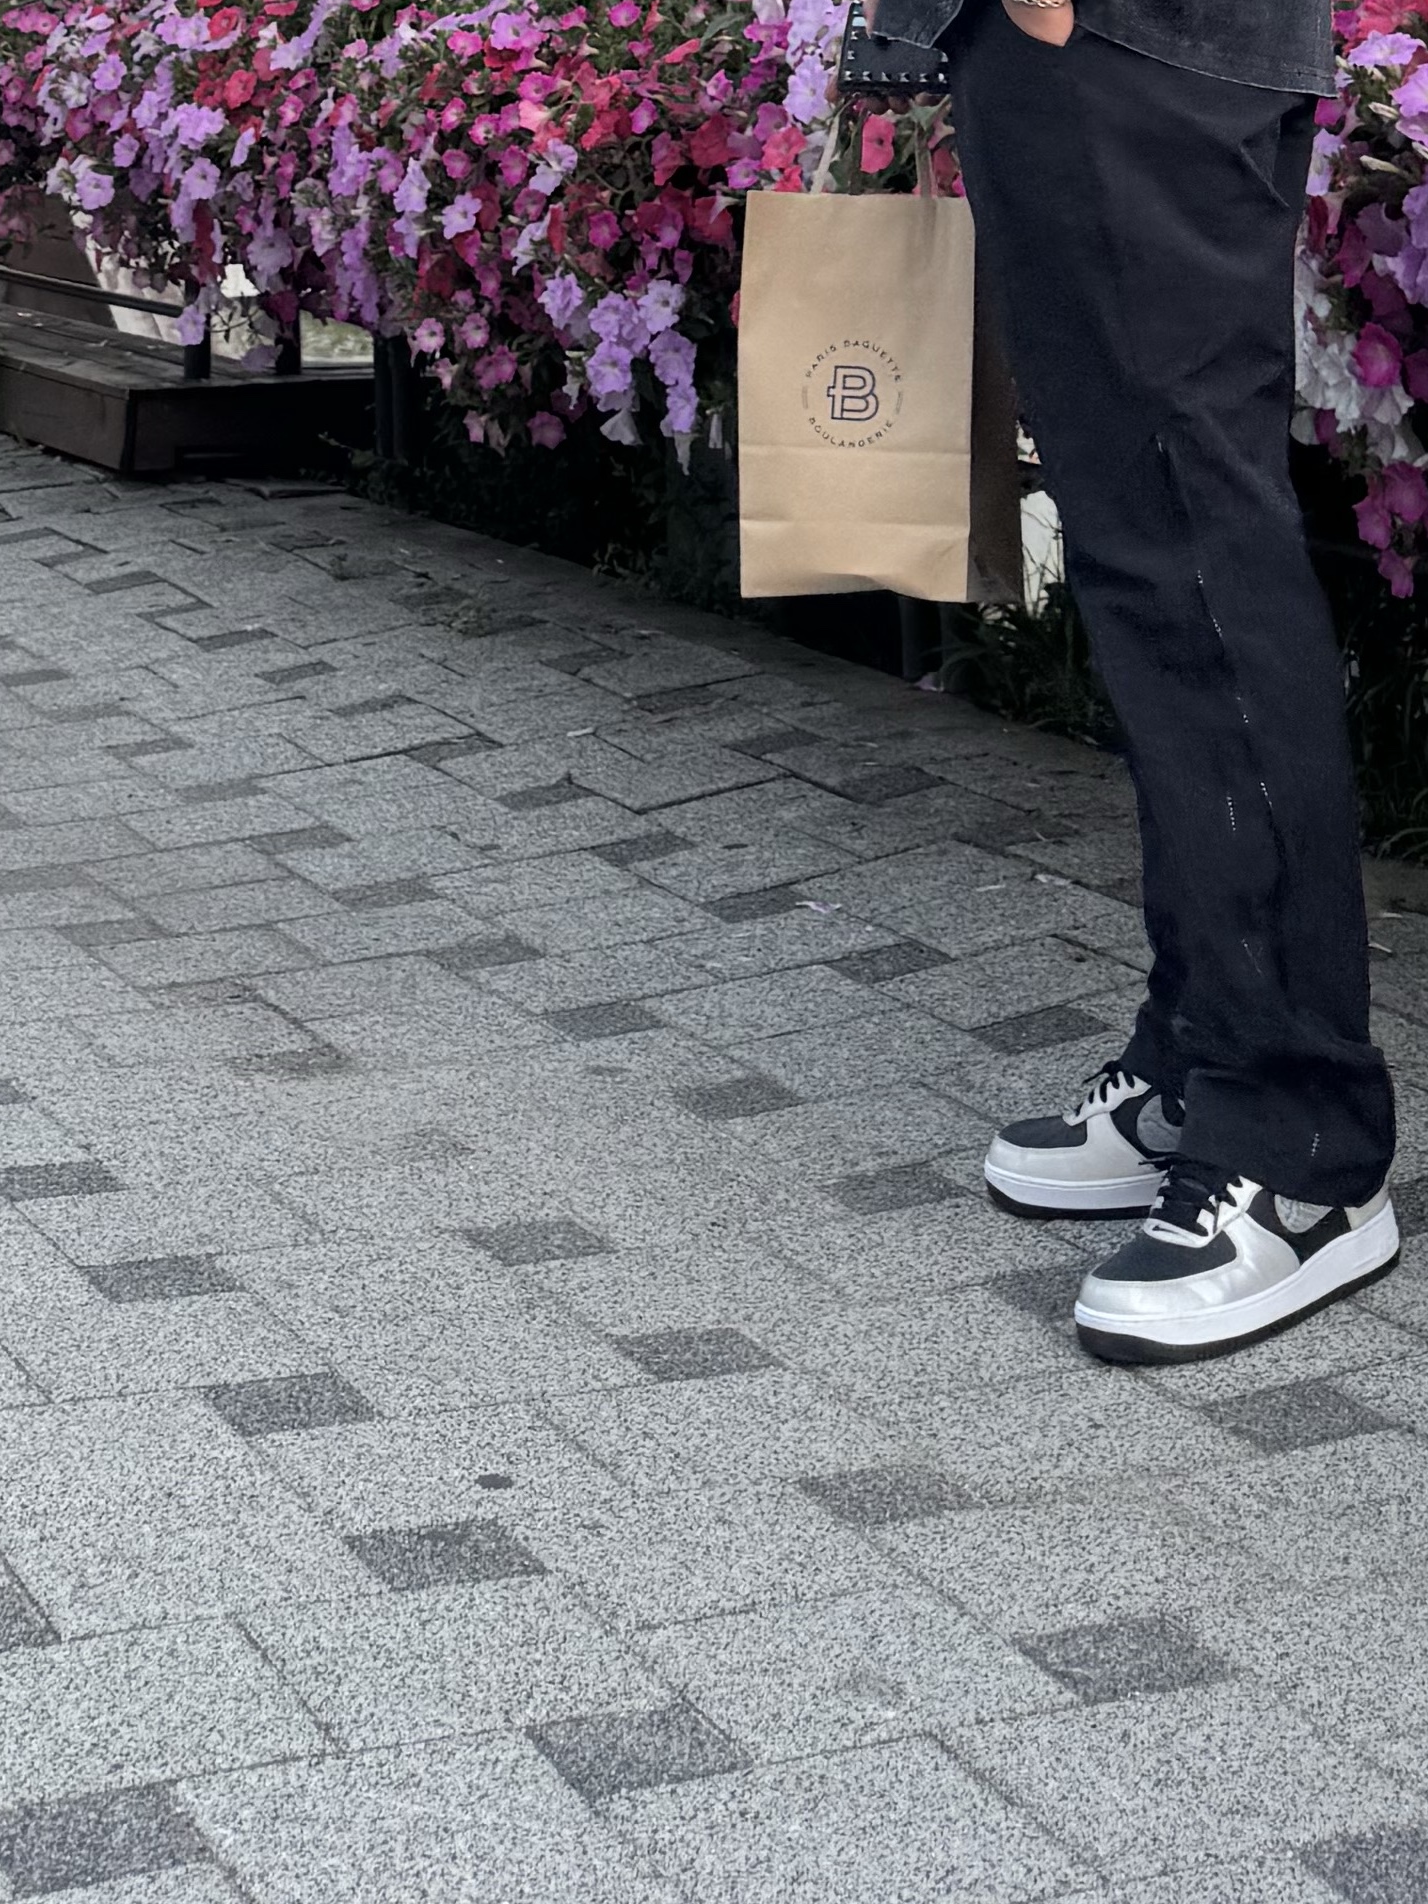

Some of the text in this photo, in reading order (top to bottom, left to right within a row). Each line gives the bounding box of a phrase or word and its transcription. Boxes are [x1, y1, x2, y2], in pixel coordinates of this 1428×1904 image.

[805, 339, 902, 383] PARIS BAGUETTE
[808, 416, 894, 448] BOULANGERIE
